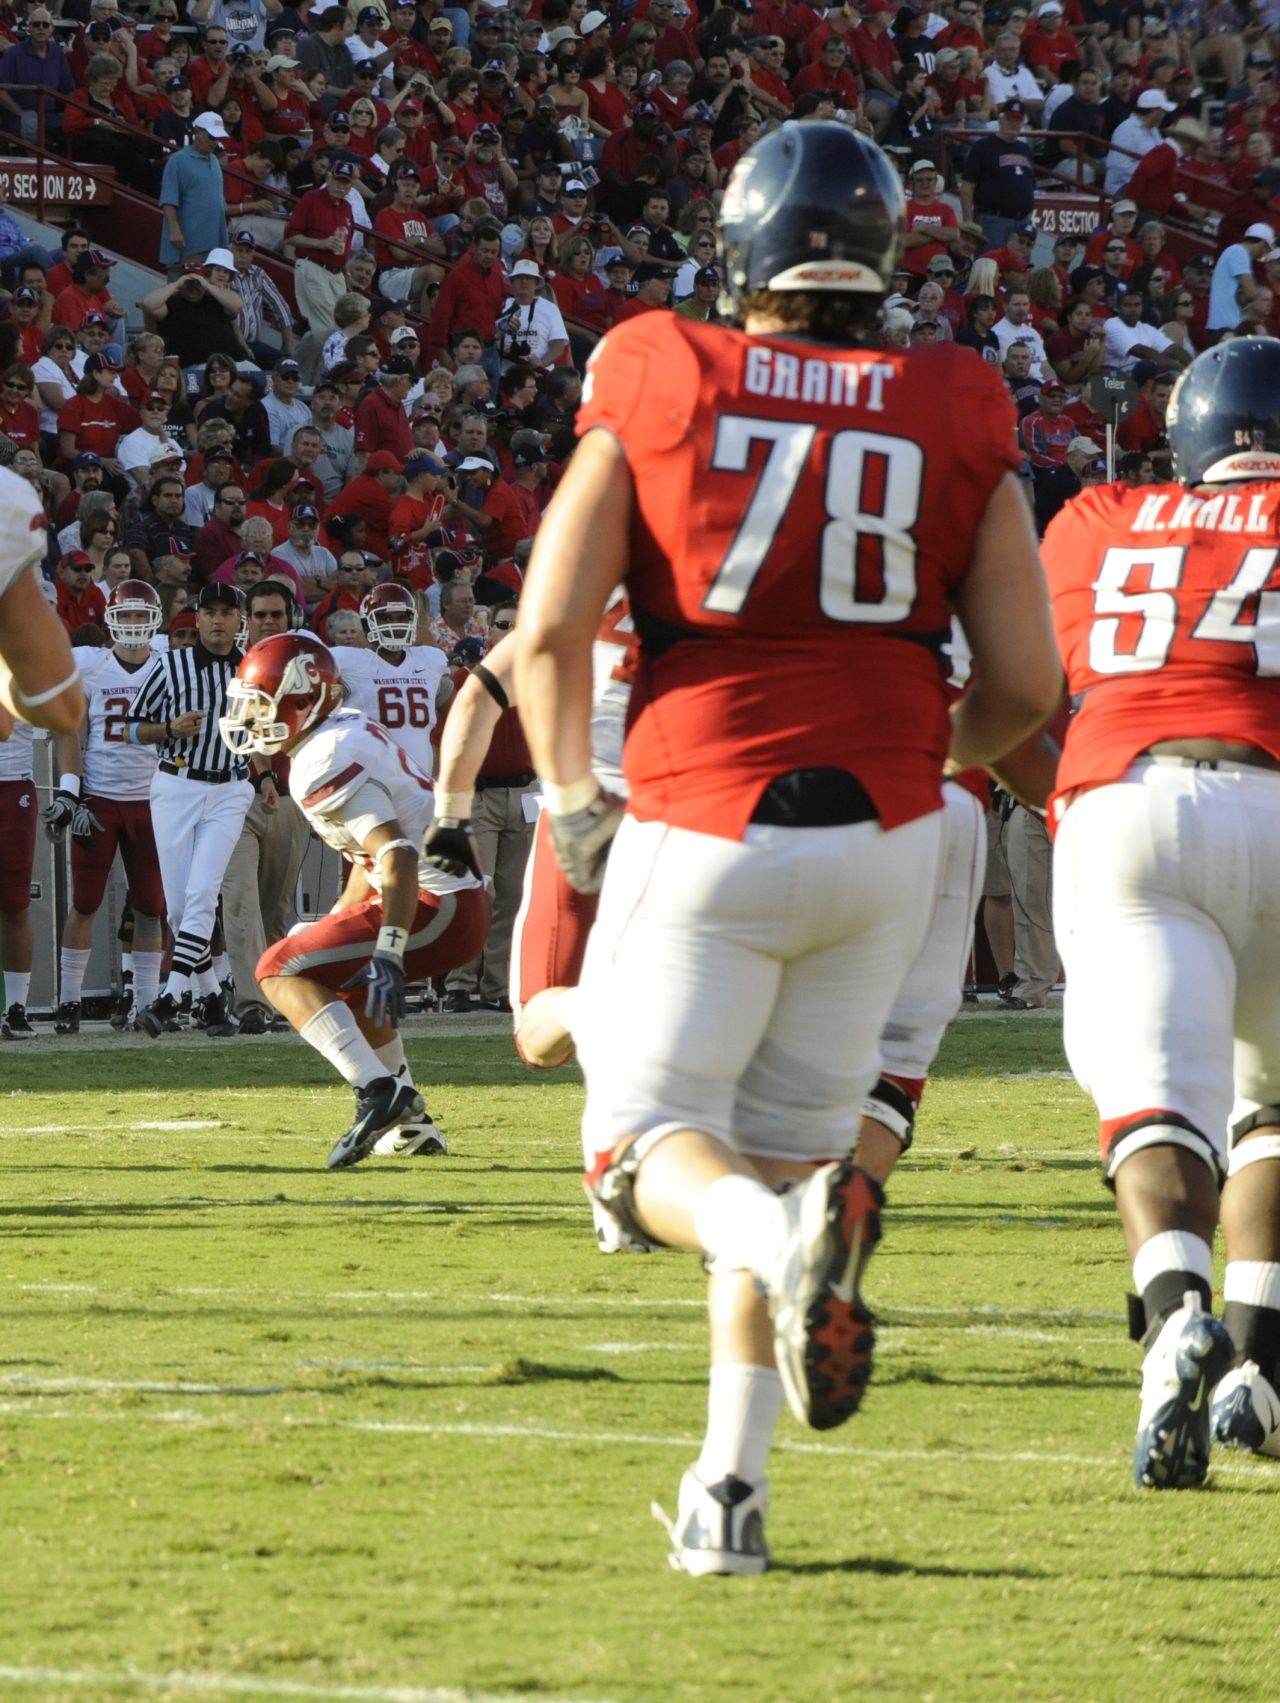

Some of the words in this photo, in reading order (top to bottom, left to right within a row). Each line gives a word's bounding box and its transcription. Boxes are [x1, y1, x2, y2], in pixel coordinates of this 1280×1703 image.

[13, 173, 64, 199] SECION
[68, 176, 82, 200] 23
[1042, 209, 1056, 232] 23
[745, 346, 895, 411] GRANT
[1103, 376, 1126, 390] Telex
[1226, 460, 1280, 471] ARIZON
[702, 412, 924, 625] 78
[1088, 545, 1280, 679] 54
[377, 686, 430, 729] 66
